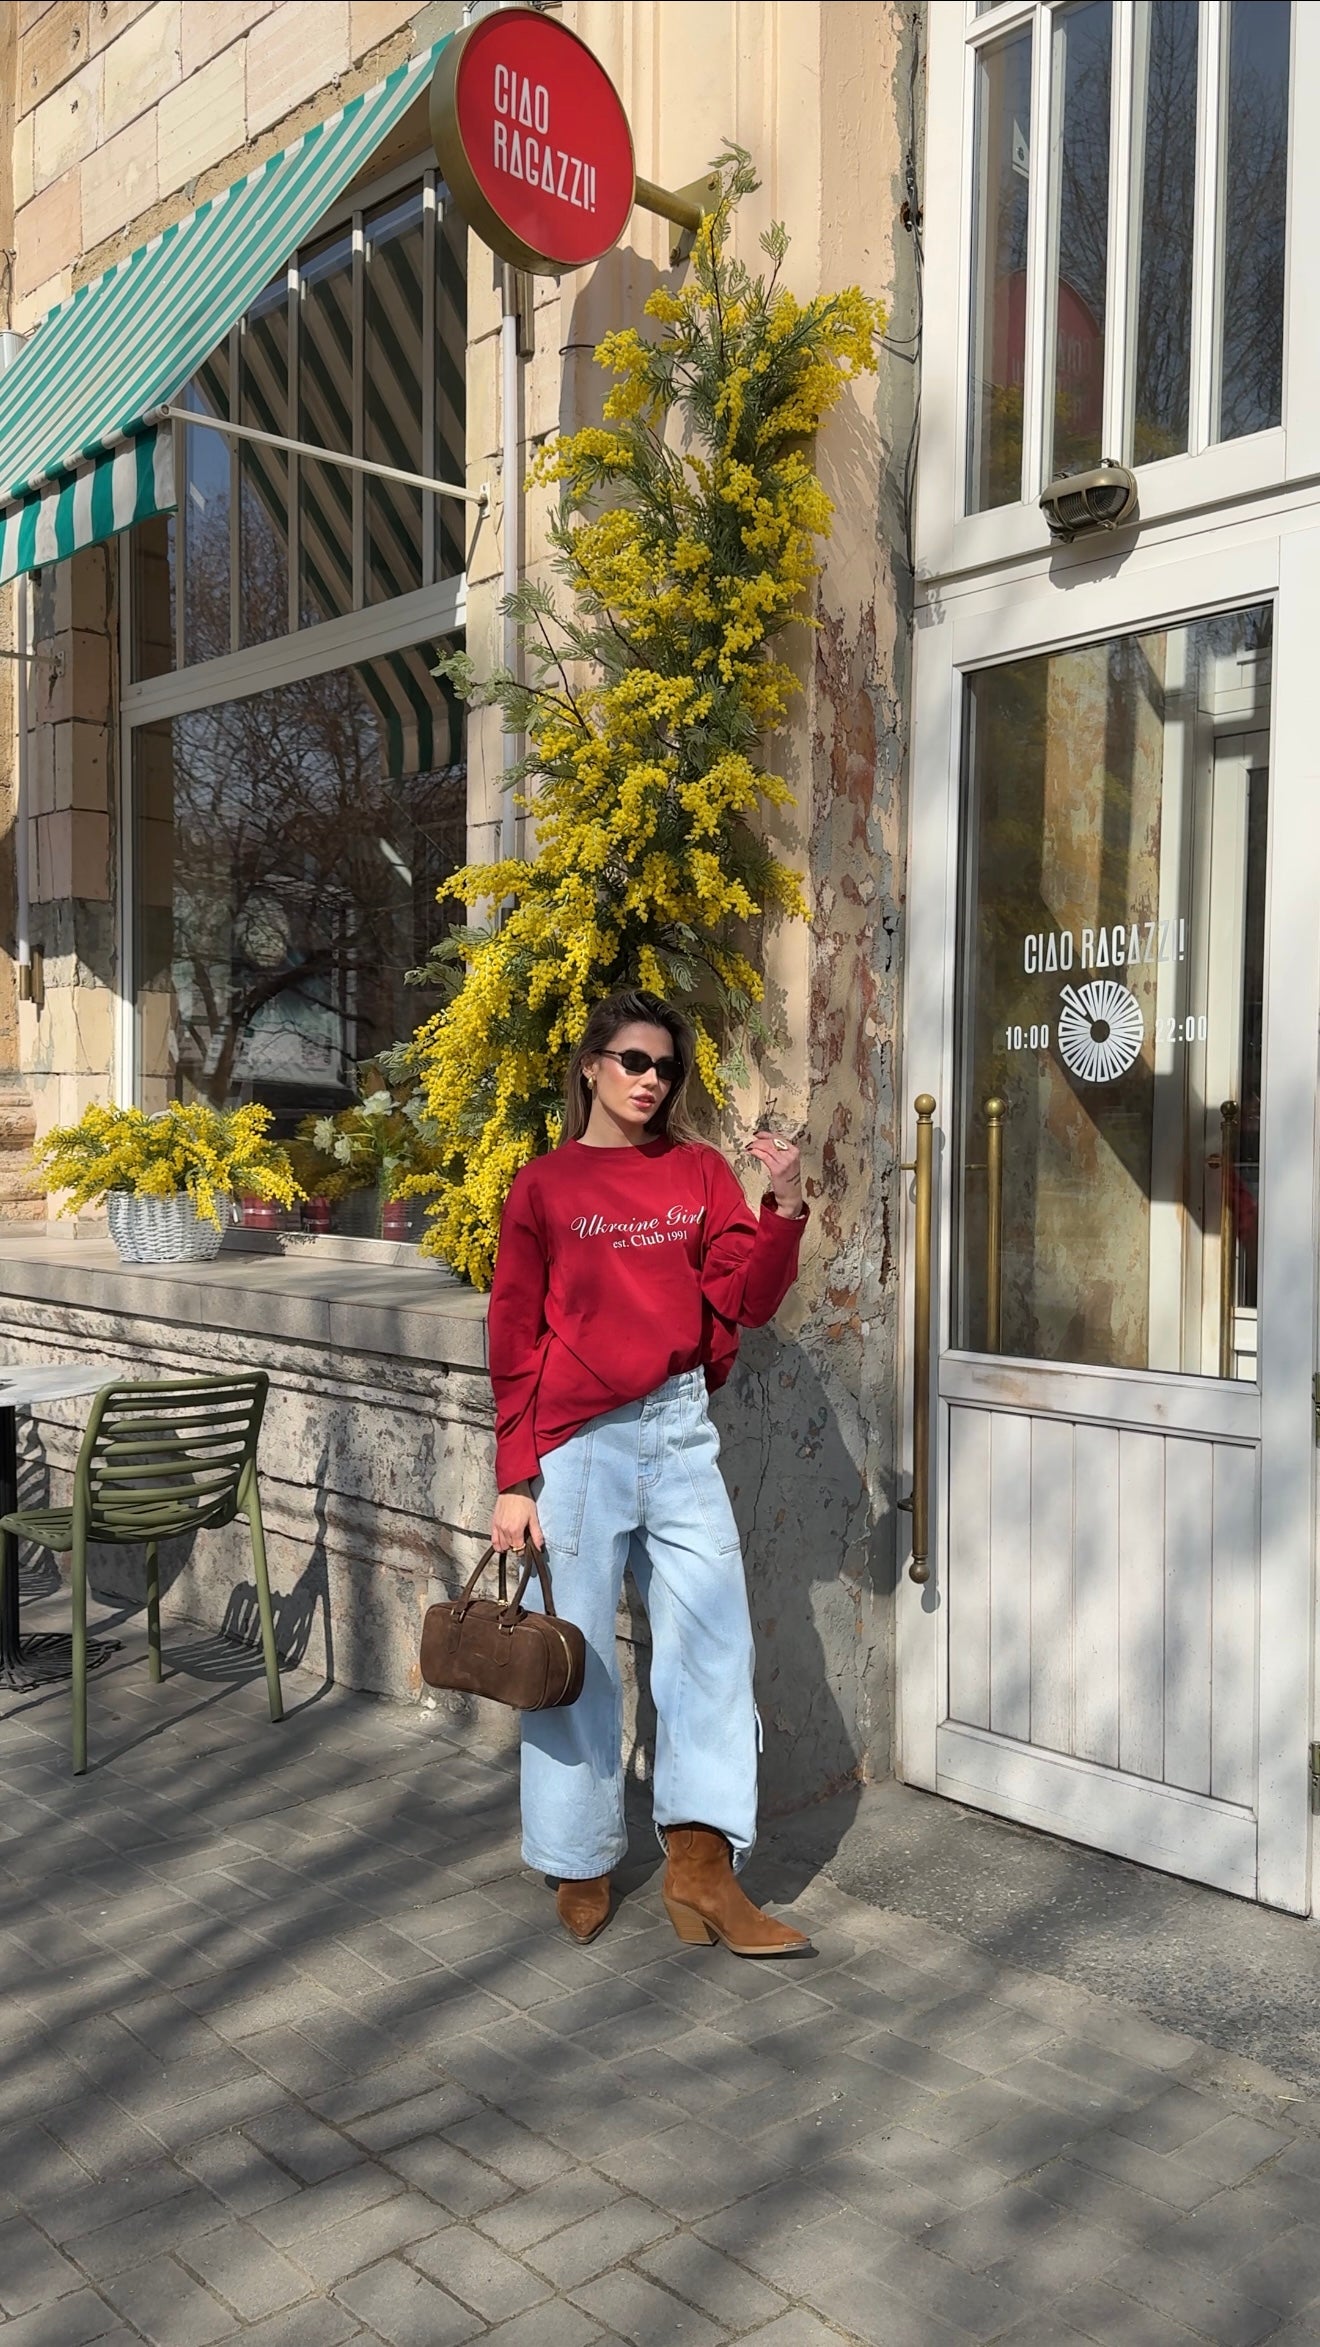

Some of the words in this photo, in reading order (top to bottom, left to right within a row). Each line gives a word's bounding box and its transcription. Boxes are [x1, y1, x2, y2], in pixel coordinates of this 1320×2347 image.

[494, 63, 549, 135] CIAO
[494, 119, 596, 213] RAGAZZI!
[1024, 930, 1073, 974] CIAO
[1081, 918, 1185, 969] RAGAZZI!
[1005, 1024, 1049, 1050] 10:00
[1155, 1015, 1207, 1043] 22:00
[570, 1214, 660, 1240] Ukraine
[612, 1239, 630, 1249] est.
[630, 1231, 665, 1247] Club
[667, 1229, 688, 1242] 1991
